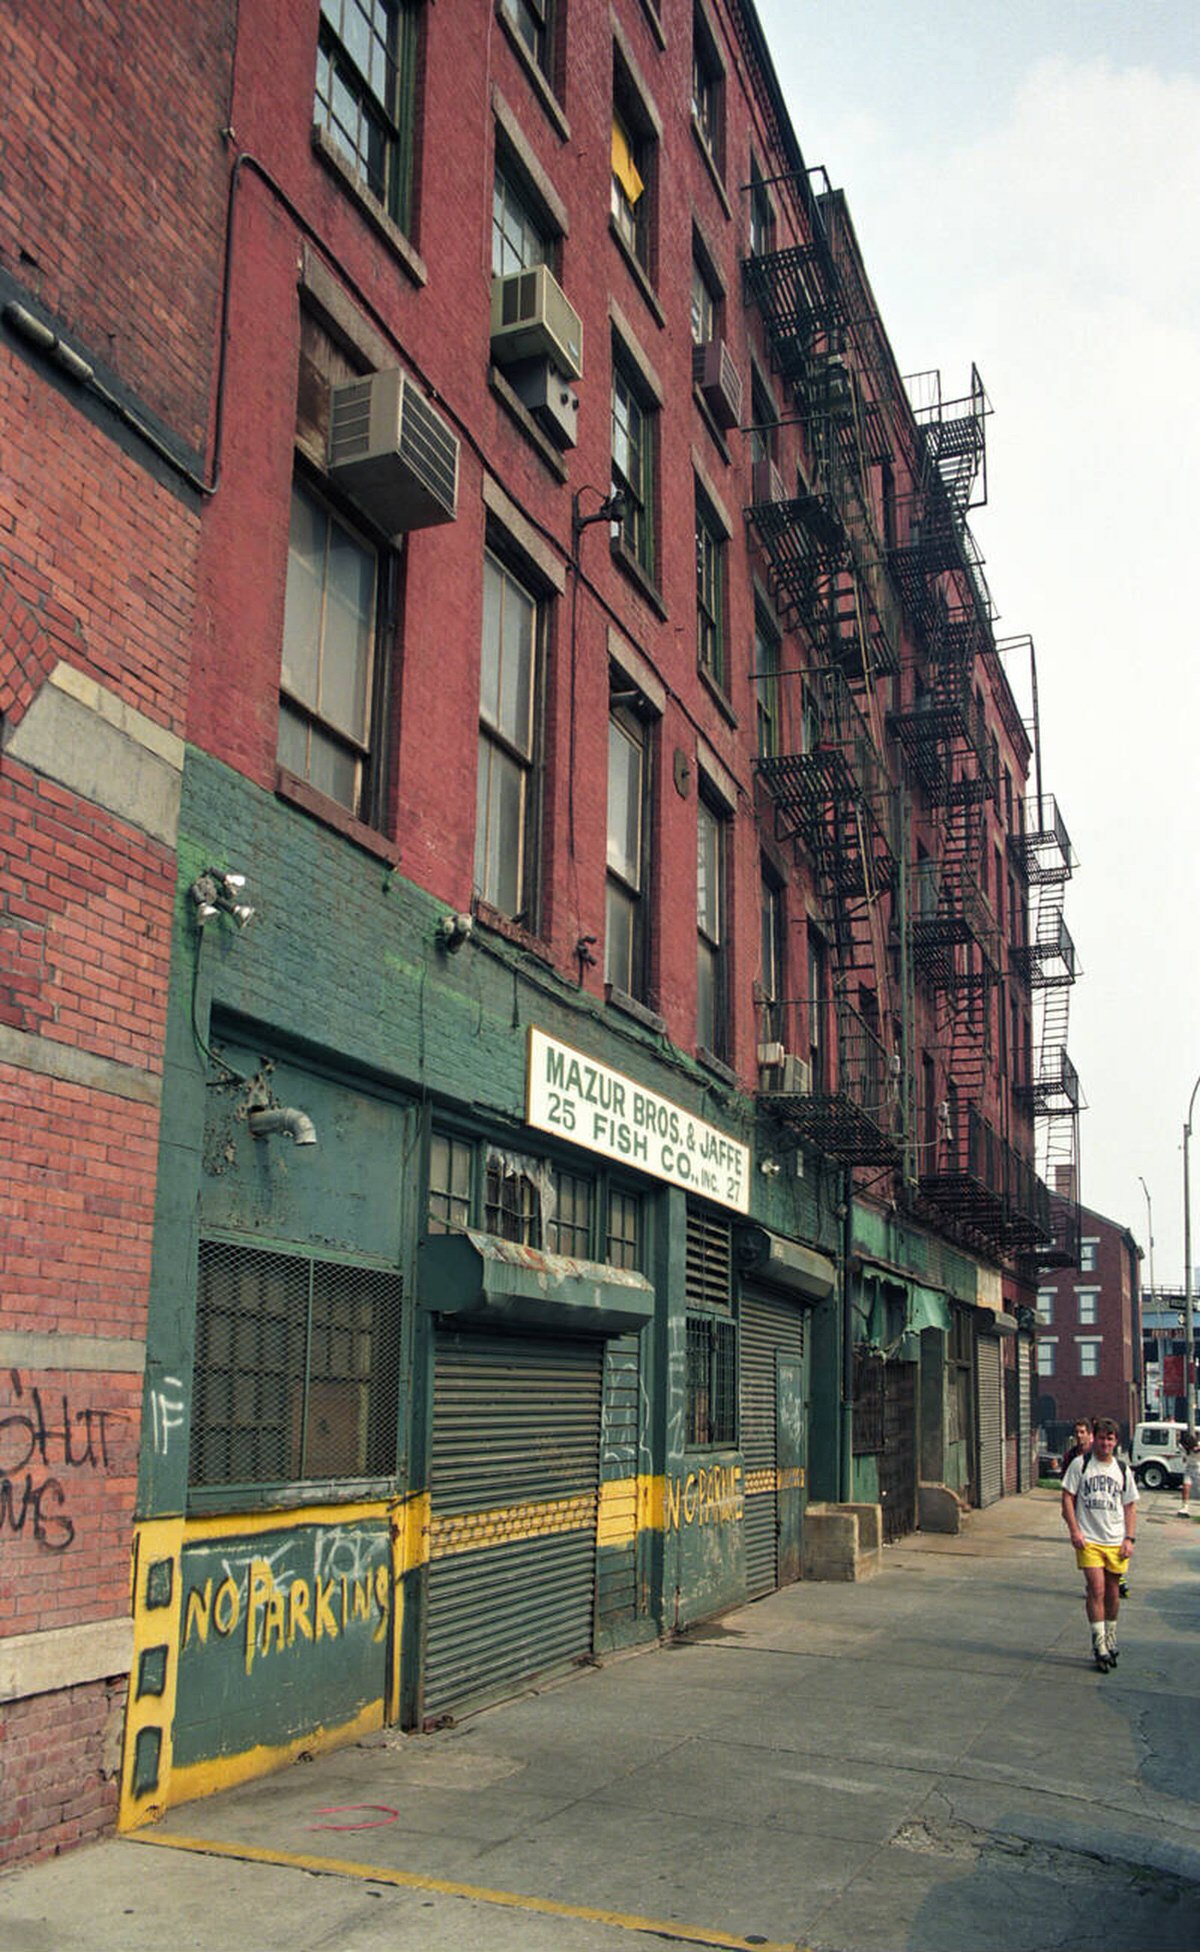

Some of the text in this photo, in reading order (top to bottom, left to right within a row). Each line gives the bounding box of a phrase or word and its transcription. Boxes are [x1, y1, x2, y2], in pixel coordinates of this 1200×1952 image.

[546, 1046, 742, 1176] MAZUR BROS. & JAFFE
[548, 1093, 576, 1131] 25
[593, 1112, 648, 1162] FISH
[727, 1176, 741, 1202] 27
[667, 1472, 697, 1535] NO
[1084, 1475, 1121, 1497] NORTH
[183, 1577, 240, 1652] NO
